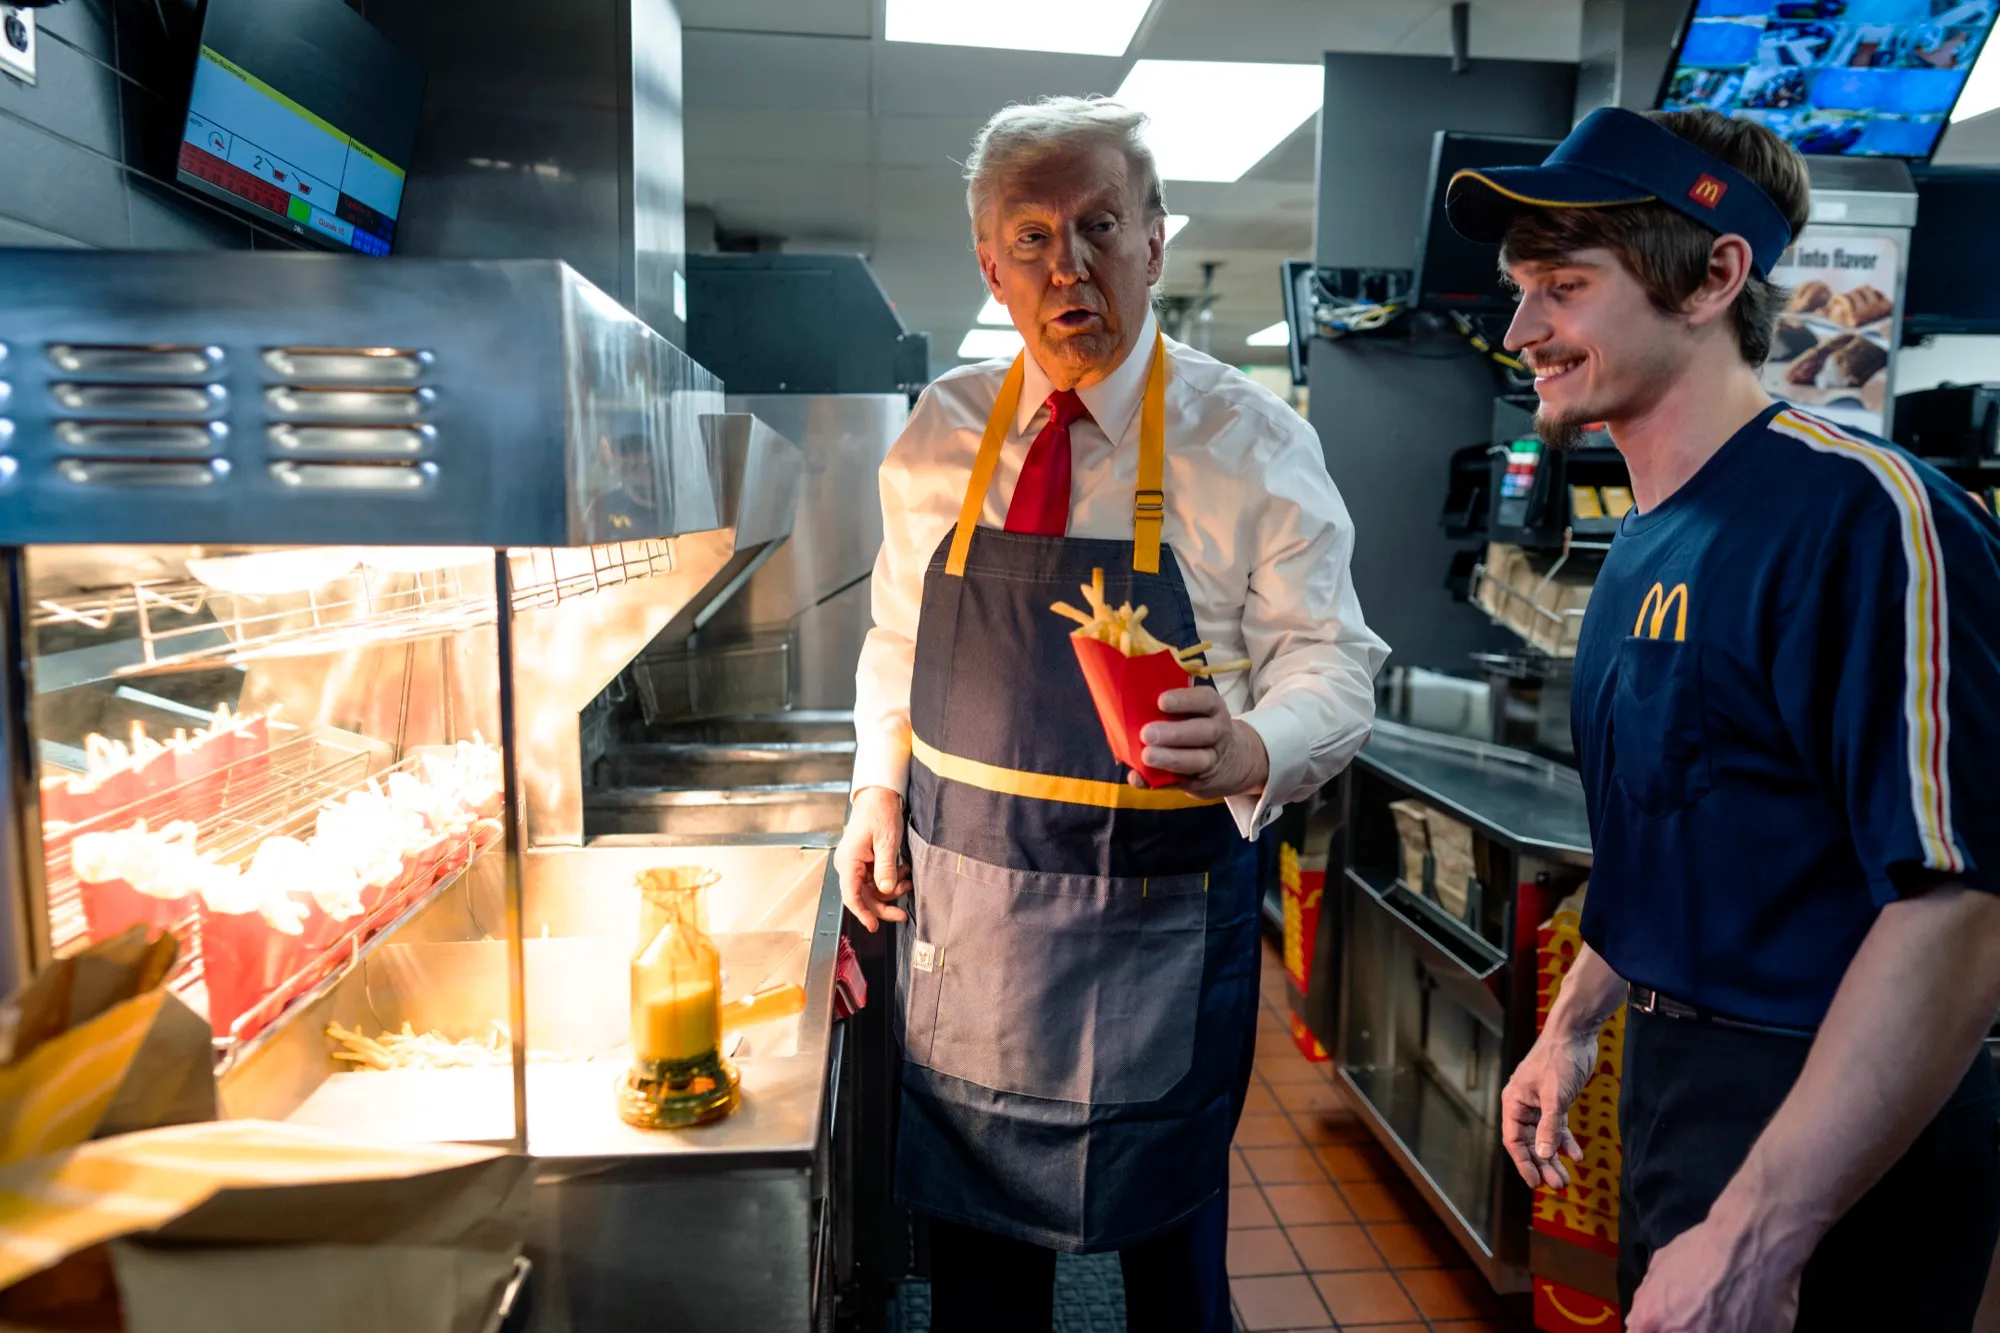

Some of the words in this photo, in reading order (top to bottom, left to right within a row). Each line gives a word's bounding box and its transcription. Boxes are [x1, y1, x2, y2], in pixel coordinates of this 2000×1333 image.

[252, 154, 263, 171] 2
[293, 224, 304, 235] DELL
[1798, 247, 1830, 268] into
[1833, 247, 1879, 269] flavor
